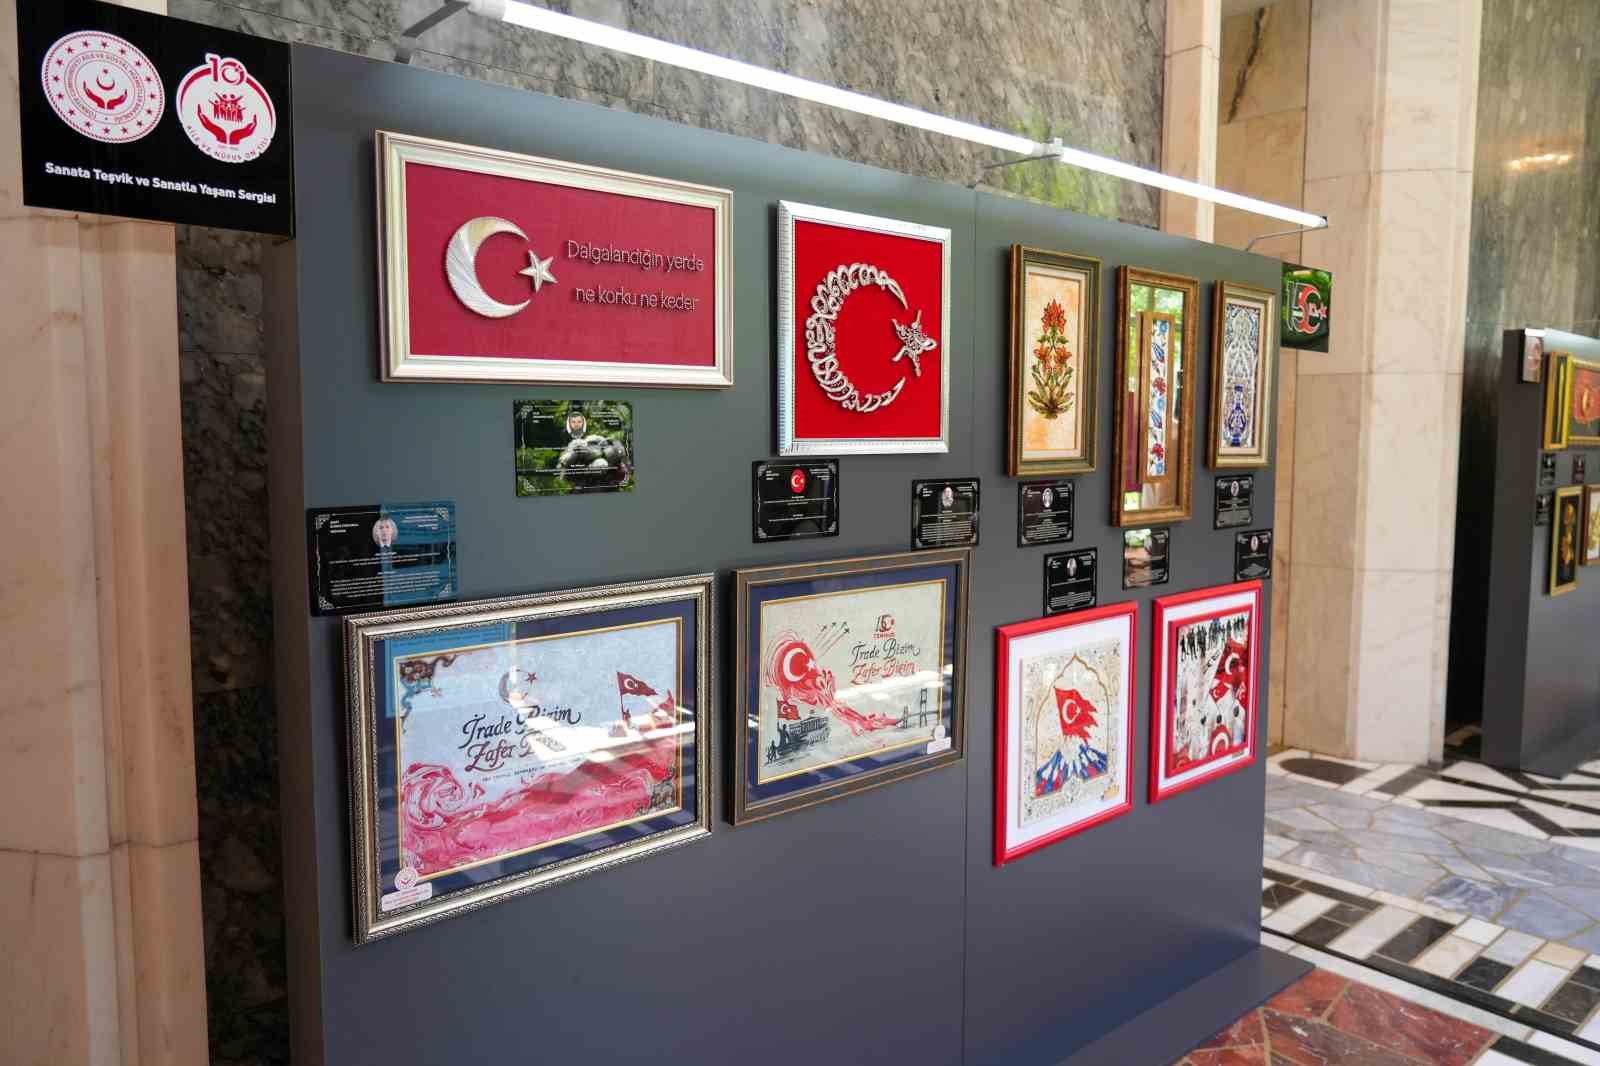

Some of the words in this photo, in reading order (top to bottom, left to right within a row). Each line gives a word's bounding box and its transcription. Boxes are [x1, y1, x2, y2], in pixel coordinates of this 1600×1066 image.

[45, 162, 91, 179] Sanata
[93, 168, 134, 185] Teşvik
[135, 176, 150, 187] ve
[152, 177, 198, 193] Sanatla
[198, 183, 236, 199] Yaşam
[238, 189, 277, 204] Sergisi
[666, 252, 705, 273] yerde
[576, 287, 595, 303] ne
[598, 284, 637, 305] korku
[640, 293, 658, 307] ne
[661, 288, 699, 312] keder
[465, 739, 516, 772] Zafer
